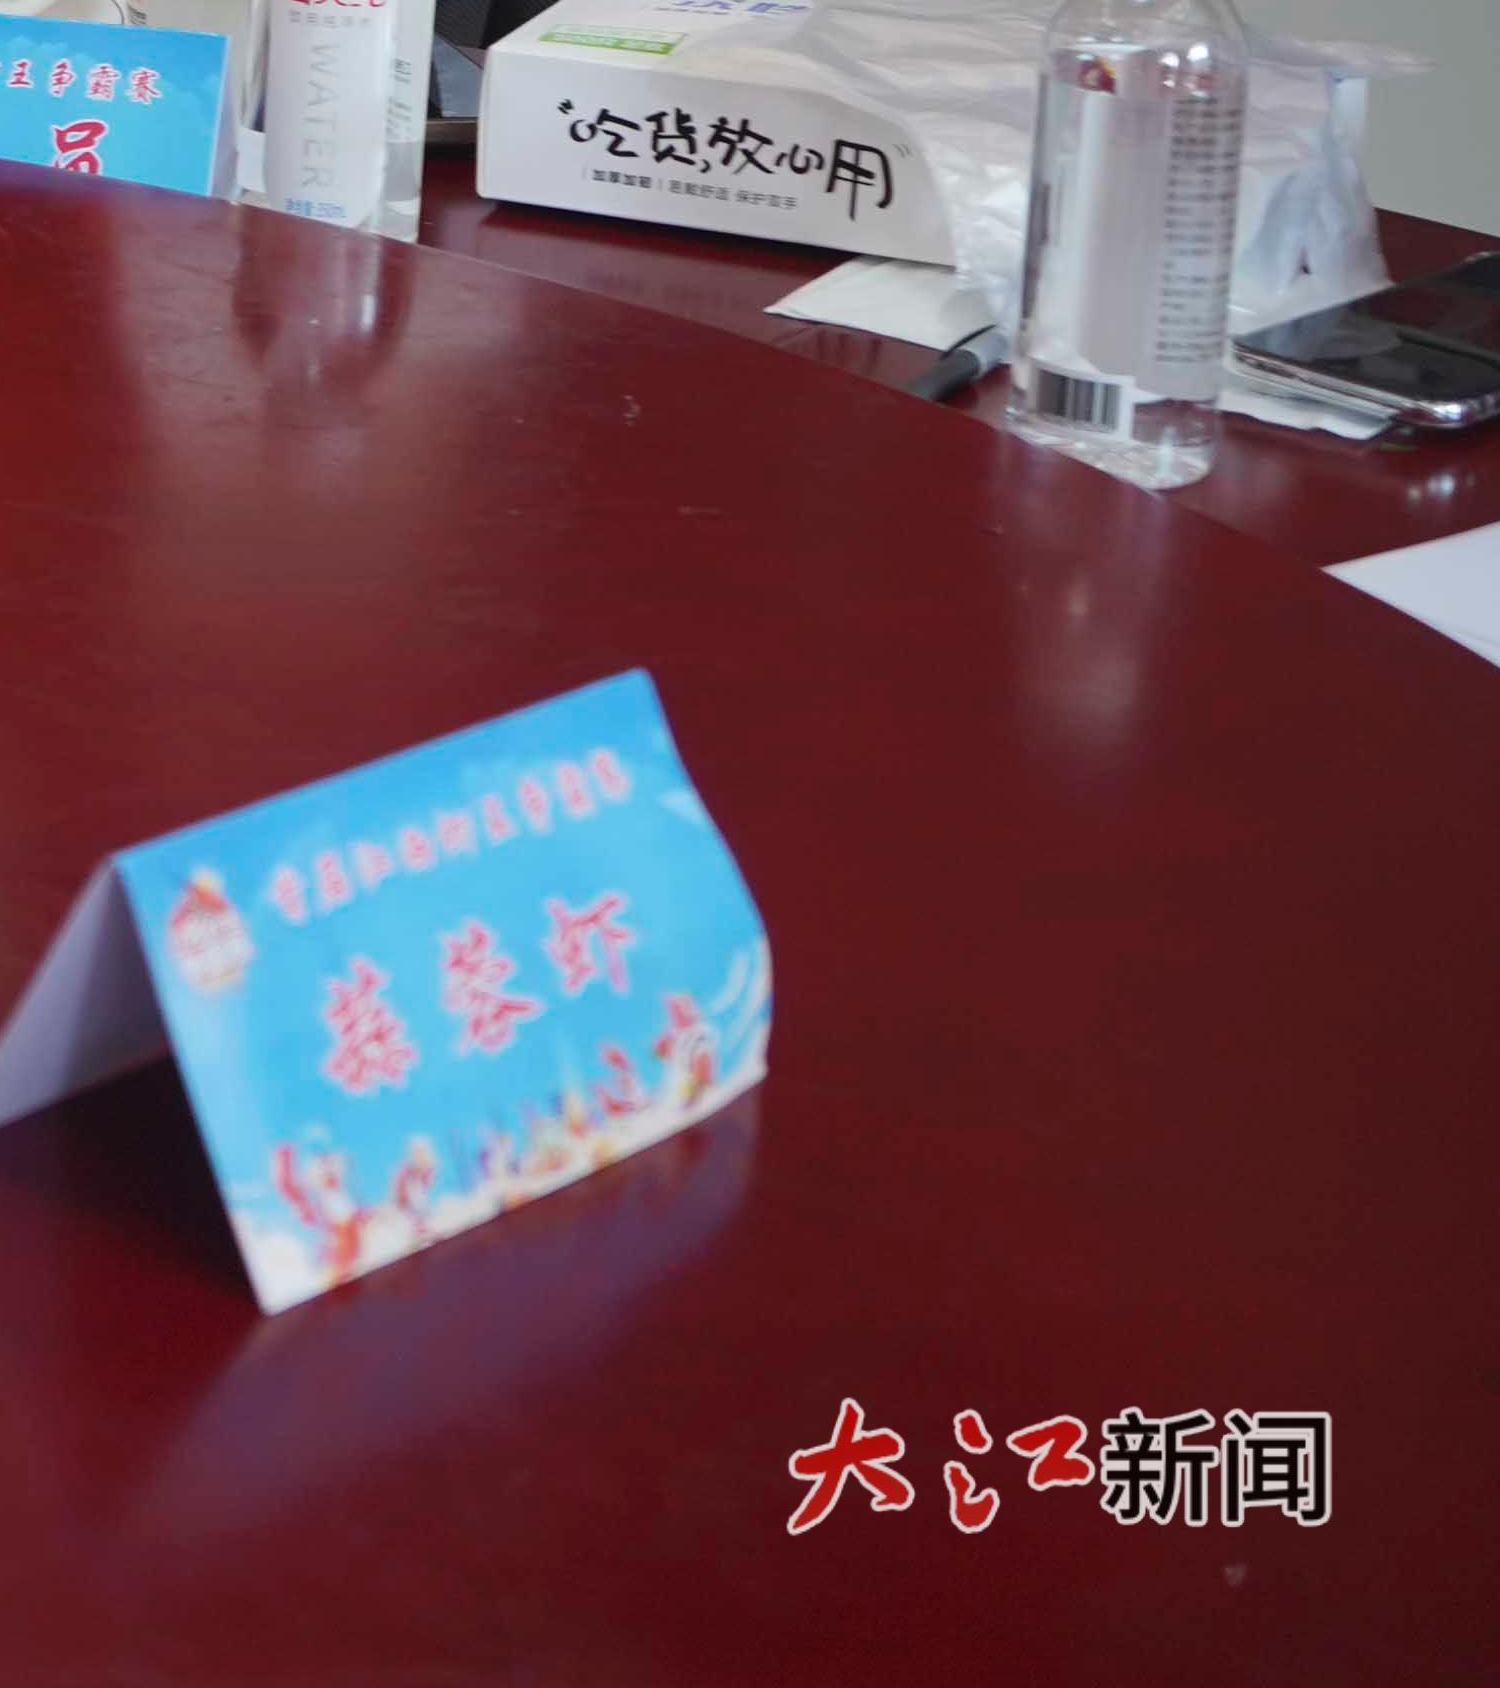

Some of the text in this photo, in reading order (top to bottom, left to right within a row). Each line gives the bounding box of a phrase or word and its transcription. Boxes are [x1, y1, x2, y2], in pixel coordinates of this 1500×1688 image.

[300, 43, 342, 188] WATER
[319, 889, 638, 1096] 蒜蓉虾
